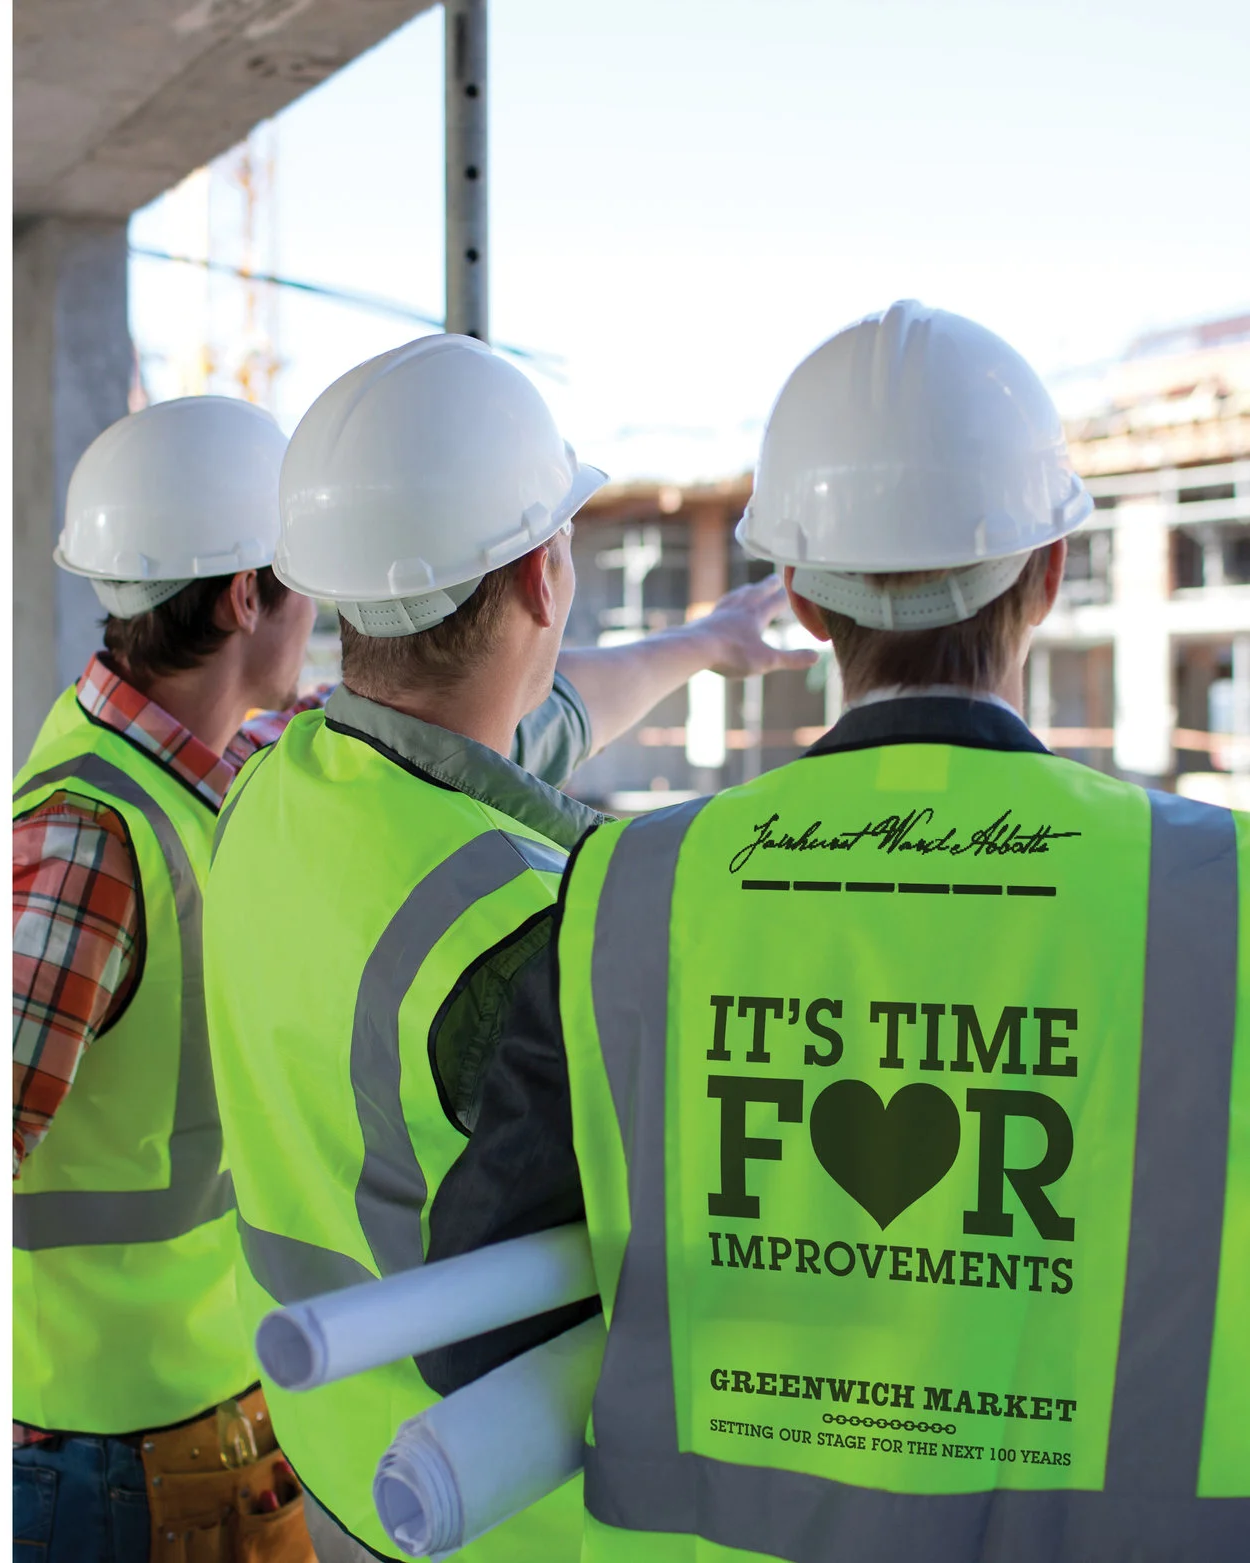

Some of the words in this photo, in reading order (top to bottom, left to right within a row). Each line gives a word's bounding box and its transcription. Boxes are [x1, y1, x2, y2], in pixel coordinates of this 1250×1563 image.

[707, 995, 844, 1067] IT'S
[870, 1001, 1078, 1078] TIME
[709, 1232, 1073, 1295] IMPROVEMENTS
[710, 1369, 915, 1409] GREENWICH
[923, 1387, 1077, 1422] MARKET
[710, 1419, 774, 1439] SETTING
[779, 1428, 812, 1444] OUR
[817, 1432, 866, 1450] STAGE
[872, 1438, 903, 1453] FOR
[907, 1441, 938, 1457] THE
[942, 1444, 985, 1460] NEXT
[990, 1448, 1016, 1463] 100
[1020, 1450, 1071, 1467] YEARS
